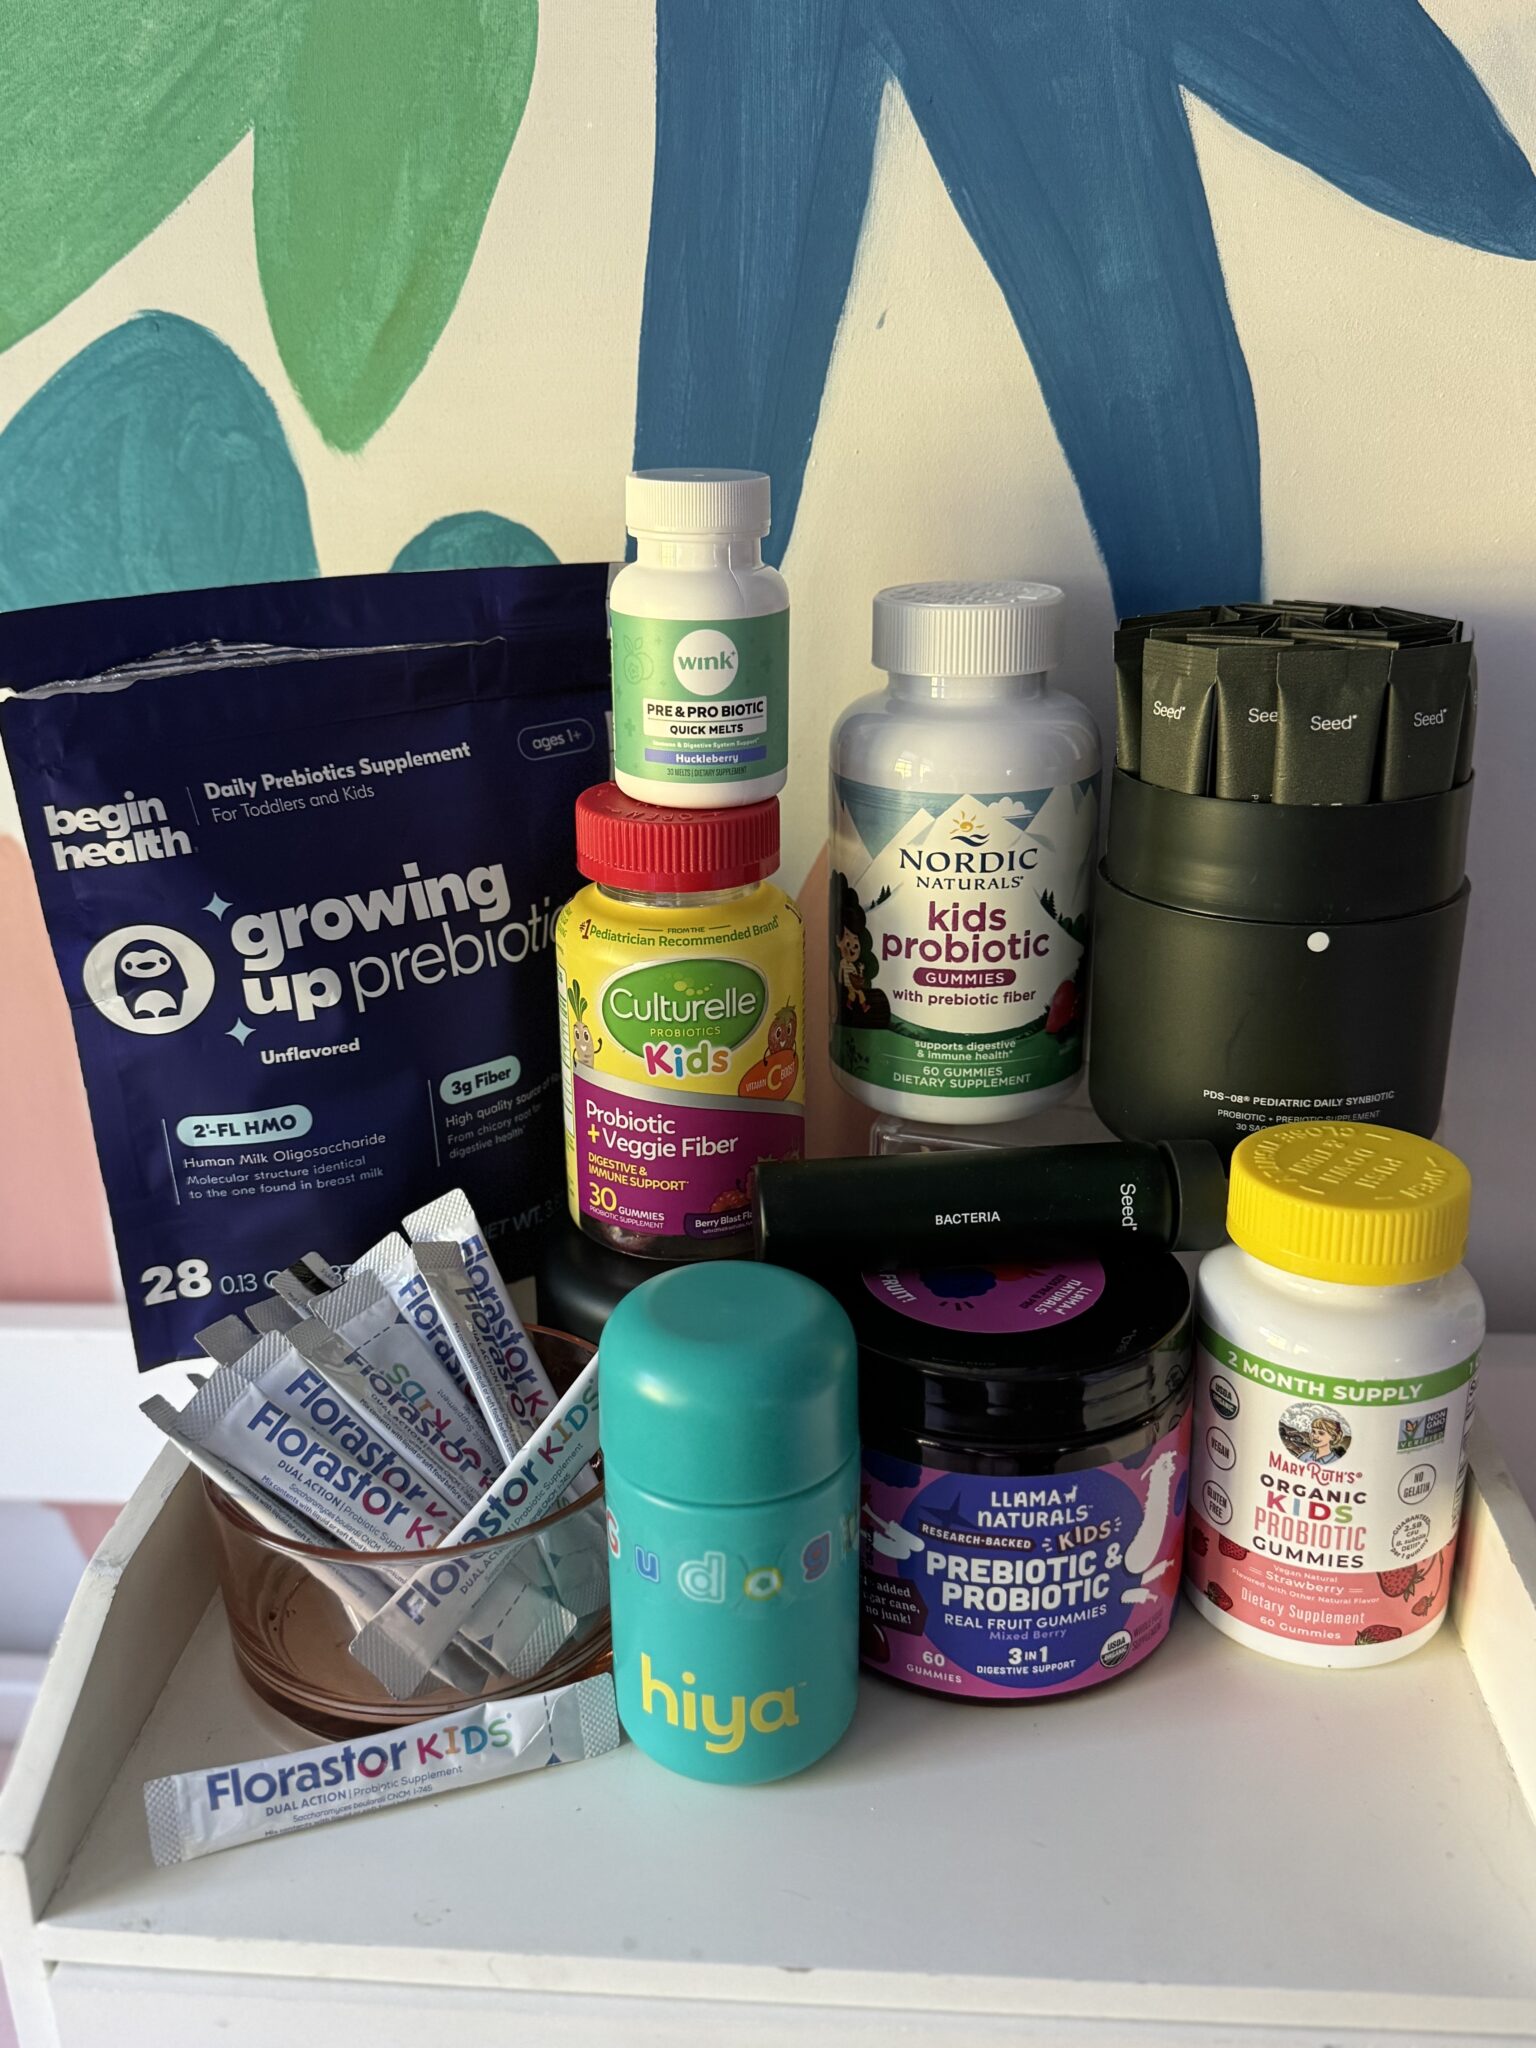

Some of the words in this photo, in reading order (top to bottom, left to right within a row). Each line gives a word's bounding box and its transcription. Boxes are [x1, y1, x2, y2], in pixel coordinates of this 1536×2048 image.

[678, 650, 735, 670] wink
[647, 704, 673, 716] PRE
[675, 706, 685, 717] &
[687, 706, 718, 718] PRO
[722, 701, 764, 716] BIOTIC
[1153, 701, 1185, 720] Seed
[1248, 708, 1278, 723] See
[1310, 714, 1358, 731] Seed
[1413, 708, 1448, 728] Seed
[532, 734, 565, 752] ages
[567, 728, 582, 743] 1+
[670, 725, 706, 735] QUICK
[709, 724, 744, 734] MELTS
[204, 778, 257, 800] Daily
[261, 763, 356, 791] Prebiotics
[358, 741, 471, 779] Supplement
[675, 753, 739, 764] Huckleberry
[43, 790, 168, 839] begin
[211, 807, 237, 823] For
[240, 796, 306, 818] Toddlers
[310, 790, 340, 806] and
[343, 784, 375, 801] Kids
[52, 826, 193, 871] health
[899, 848, 1038, 874] NORDIC
[917, 876, 1021, 890] NATURALS
[231, 861, 511, 971] growing
[928, 901, 1007, 932] kids
[590, 925, 656, 946] Pediatrician
[658, 928, 751, 947] Recommended
[882, 930, 1050, 964] probiotic
[925, 972, 1005, 985] GUMMIES
[242, 967, 342, 1021] up
[609, 987, 756, 1023] Culturelle
[893, 989, 923, 1004] with
[928, 993, 999, 1006] prebiotic
[1003, 989, 1036, 1003] fiber
[650, 1026, 721, 1038] PROBIOTICS
[914, 1040, 964, 1051] supports
[966, 1039, 1016, 1051] digestive
[260, 1037, 361, 1065] Unflavored
[645, 1042, 729, 1078] Kids
[917, 1050, 925, 1059] &
[927, 1050, 972, 1061] immune
[451, 1081, 472, 1096] 3g
[475, 1068, 512, 1089] Fiber
[767, 1064, 782, 1091] C
[893, 1072, 945, 1088] DIETARY
[949, 1073, 1032, 1089] SUPPLEMENT
[923, 1066, 940, 1077] 60
[943, 1067, 1003, 1078] GUMMIES
[1252, 1096, 1311, 1108] PEDIATRIC
[1313, 1098, 1343, 1107] DAILY
[1345, 1090, 1395, 1106] SYNBIOTIC
[193, 1122, 241, 1138] 2'-FL
[244, 1114, 297, 1136] HMO
[445, 1113, 474, 1128] High
[477, 1100, 513, 1119] quality
[586, 1099, 676, 1135] Probiotic
[1217, 1109, 1266, 1122] PROBIOTIC
[184, 1155, 235, 1169] Human
[239, 1152, 269, 1165] Milk
[273, 1133, 386, 1163] Oligosaccharide
[447, 1131, 474, 1145] From
[587, 1123, 600, 1144] +
[602, 1127, 677, 1161] Veggie
[681, 1136, 739, 1158] Fiber
[187, 1173, 249, 1186] Molecular
[254, 1168, 309, 1181] structure
[313, 1156, 366, 1175] identical
[588, 1151, 638, 1175] DIGESTIVE
[638, 1166, 648, 1176] &
[588, 1163, 629, 1185] IMMUNE
[189, 1190, 203, 1199] to
[207, 1187, 227, 1198] the
[232, 1185, 256, 1196] one
[259, 1181, 297, 1193] found
[300, 1180, 313, 1190] in
[316, 1173, 356, 1188] breast
[359, 1167, 384, 1181] milk
[589, 1182, 617, 1212] 30
[618, 1206, 665, 1221] GUMMIES
[1119, 1183, 1138, 1232] Seed
[589, 1205, 619, 1222] PROBIOTIC
[619, 1215, 664, 1229] SUPPLEMENT
[695, 1219, 719, 1228] Berry
[720, 1214, 741, 1225] Blast
[934, 1211, 1001, 1226] BACTERIA
[140, 1258, 212, 1307] 28
[220, 1273, 258, 1295] 0.13
[880, 1273, 918, 1304] FRUIT!
[461, 1234, 538, 1391] Florastor
[1227, 1352, 1238, 1367] 2
[1243, 1359, 1325, 1398] MONTH
[1333, 1384, 1424, 1402] SUPPLY
[285, 1369, 428, 1503] Florastor
[1211, 1437, 1230, 1459] VEGAN
[247, 1400, 411, 1525] Florastor
[278, 1459, 304, 1482] DUAL
[304, 1478, 342, 1507] ACTION
[344, 1506, 381, 1537] Probiotic
[514, 1489, 545, 1528] Probiotic
[544, 1443, 583, 1491] Supplement
[991, 1489, 1061, 1508] LLAMA
[1207, 1485, 1227, 1508] GLUTEN
[1260, 1473, 1367, 1504] ORGANIC
[1403, 1482, 1431, 1499] GELATIN
[977, 1505, 1089, 1528] NATURALS
[1266, 1491, 1353, 1523] KIDS
[921, 1523, 1032, 1550] RESEARCH-BACKED
[1058, 1520, 1112, 1551] KIDS
[1254, 1506, 1367, 1551] PROBIOTIC
[925, 1550, 1097, 1585] PREBIOTIC
[1104, 1542, 1124, 1569] &
[1253, 1535, 1364, 1568] GUMMIES
[1232, 1567, 1265, 1588] Flavored
[1267, 1585, 1287, 1596] with
[1289, 1591, 1315, 1601] Other
[1318, 1596, 1351, 1604] Natural
[1266, 1570, 1344, 1596] Strawberry
[1273, 1564, 1301, 1577] Vegan
[1304, 1573, 1338, 1583] Natural
[876, 1582, 911, 1598] added
[942, 1573, 1111, 1613] PROBIOTIC
[881, 1608, 911, 1624] junk!
[944, 1613, 983, 1629] REAL
[987, 1617, 1032, 1630] FRUIT
[1036, 1604, 1107, 1629] GUMMIES
[1241, 1587, 1285, 1616] Dietary
[1289, 1605, 1365, 1625] Supplement
[989, 1630, 1030, 1641] Mixed
[1033, 1628, 1067, 1643] Berry
[1260, 1616, 1275, 1627] 60
[1279, 1622, 1341, 1640] Gummies
[922, 1651, 945, 1667] 60
[977, 1664, 1029, 1675] DIGESTIVE
[1032, 1659, 1076, 1674] SUPPORT
[1008, 1648, 1022, 1664] 3
[1024, 1650, 1037, 1661] IN
[1039, 1646, 1049, 1663] 1
[906, 1663, 962, 1684] GUMMIES
[640, 1651, 799, 1754] hiya
[206, 1737, 408, 1811] Florastor
[416, 1719, 512, 1765] KIDS
[265, 1802, 298, 1817] DUAL
[301, 1791, 347, 1809] ACTION
[353, 1779, 399, 1798] Probiotic
[400, 1765, 463, 1786] Supplement
[386, 1790, 411, 1801] CNCM
